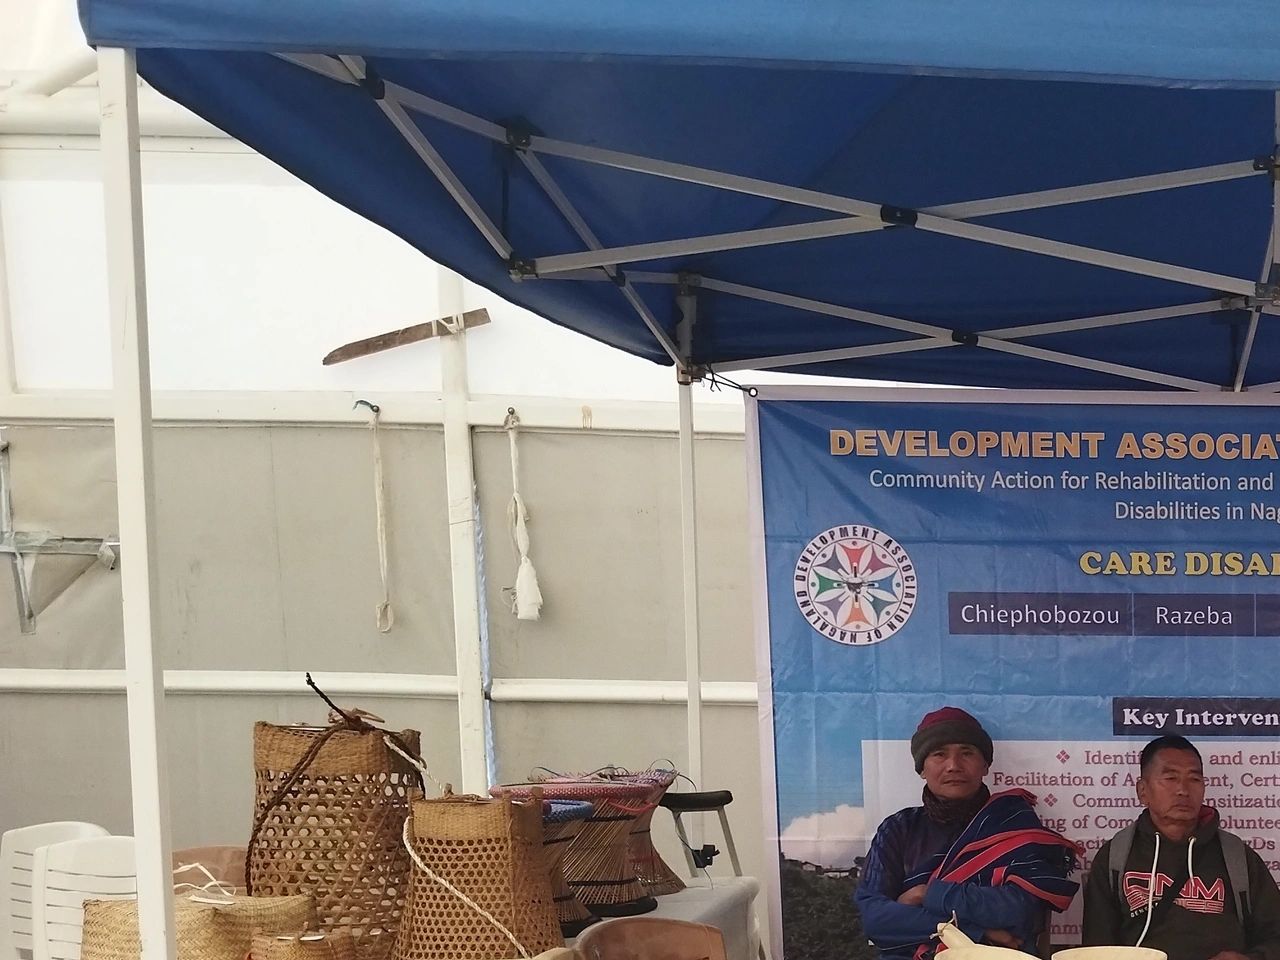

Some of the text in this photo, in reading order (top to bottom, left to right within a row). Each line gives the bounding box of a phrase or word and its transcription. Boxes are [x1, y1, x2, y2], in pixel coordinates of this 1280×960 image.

[830, 429, 1105, 458] DEVELOPMENT
[869, 469, 986, 492] Community
[991, 470, 1055, 490] Action
[1060, 470, 1089, 490] for
[1095, 471, 1230, 491] Rehabilitation
[1237, 472, 1274, 491] and
[1114, 500, 1221, 520] Disabilities
[1226, 502, 1245, 520] in
[1078, 551, 1177, 577] CARE
[795, 526, 916, 643] DEVELOPMENT ASSOCIATION OF NAGALAND
[961, 604, 1120, 628] Chiephobozou
[1156, 606, 1233, 625] Razeba
[1122, 708, 1170, 729] Key
[1209, 751, 1243, 765] and
[992, 772, 1094, 787] Facilitation
[1100, 772, 1119, 787] of
[1072, 814, 1090, 829] of
